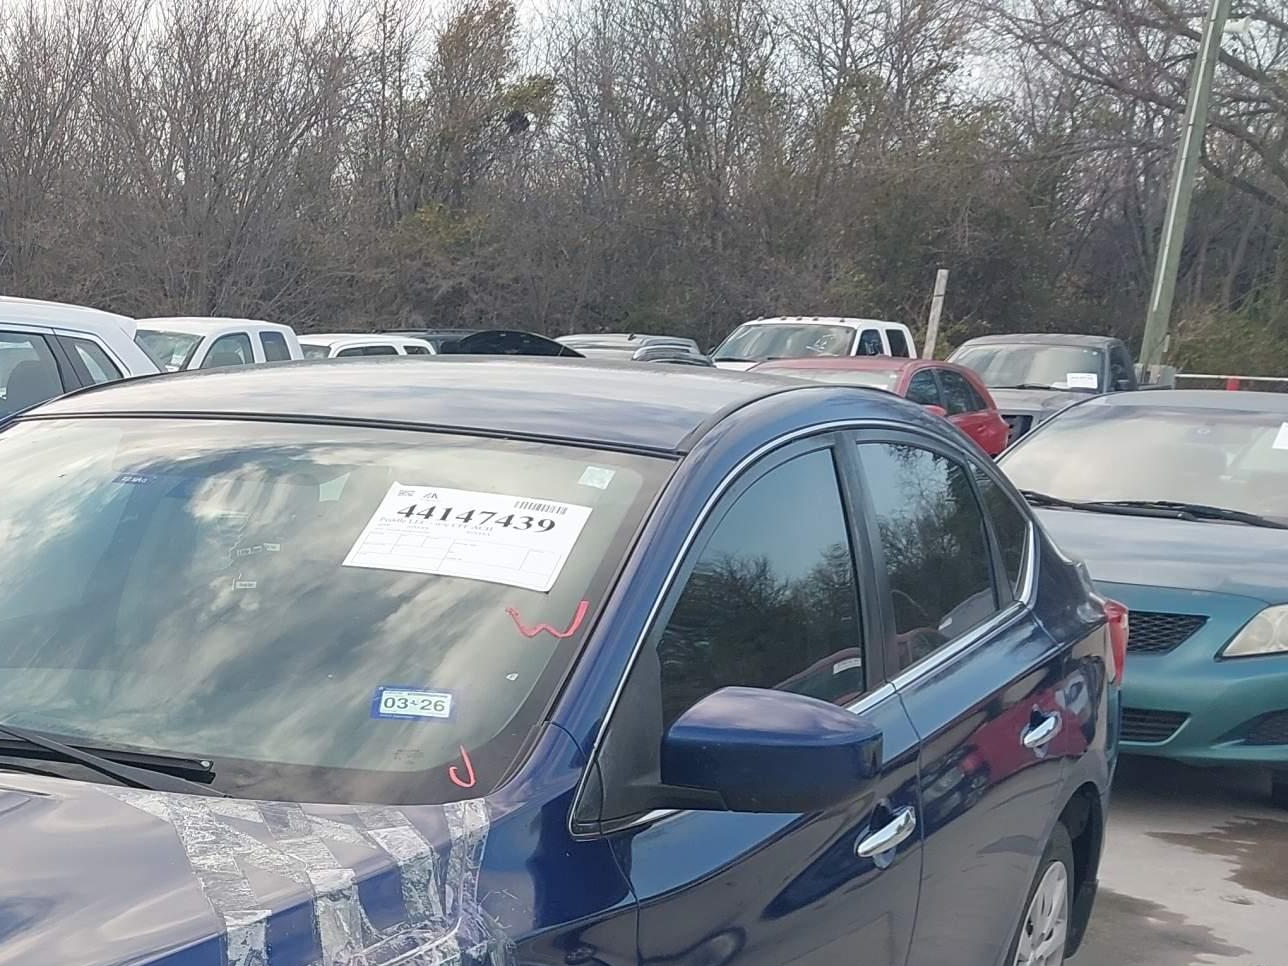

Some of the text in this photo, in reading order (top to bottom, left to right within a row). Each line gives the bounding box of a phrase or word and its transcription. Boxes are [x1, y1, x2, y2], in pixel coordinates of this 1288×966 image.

[397, 503, 556, 533] 44147439
[384, 697, 445, 712] 03 26
